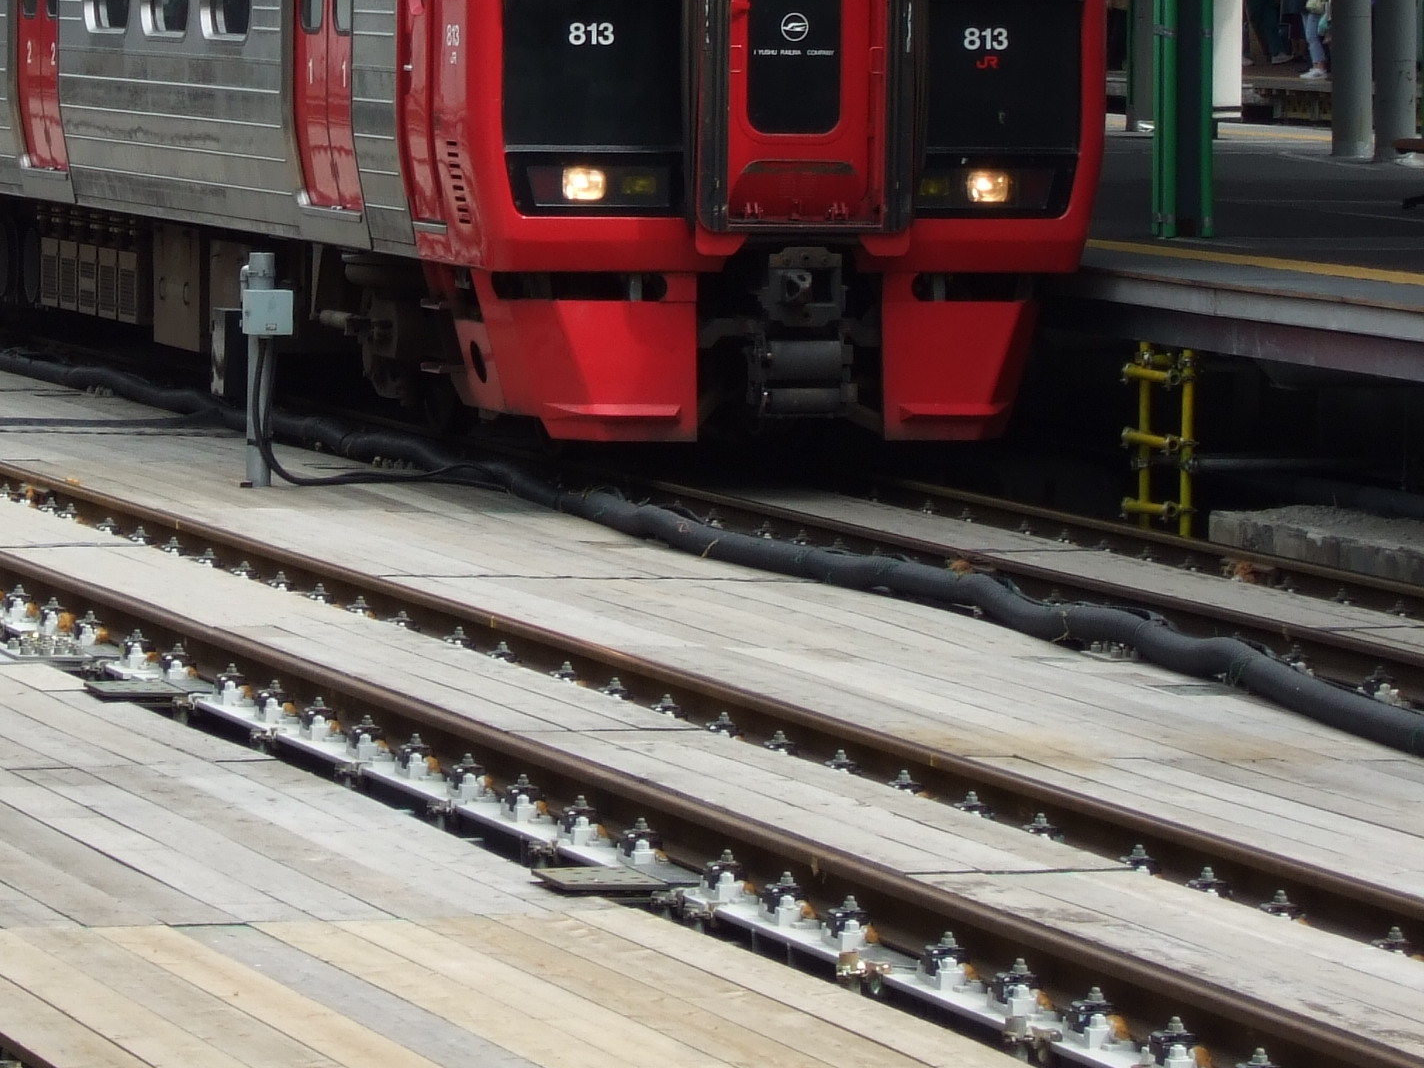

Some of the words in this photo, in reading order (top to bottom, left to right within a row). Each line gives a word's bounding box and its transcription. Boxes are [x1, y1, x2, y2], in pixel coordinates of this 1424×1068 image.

[446, 24, 459, 47] 813
[569, 22, 615, 45] 813
[964, 27, 1009, 50] 813
[26, 40, 32, 64] 2
[50, 41, 56, 66] 2
[977, 56, 999, 69] JR
[308, 58, 313, 84] 1
[341, 60, 346, 88] 1
